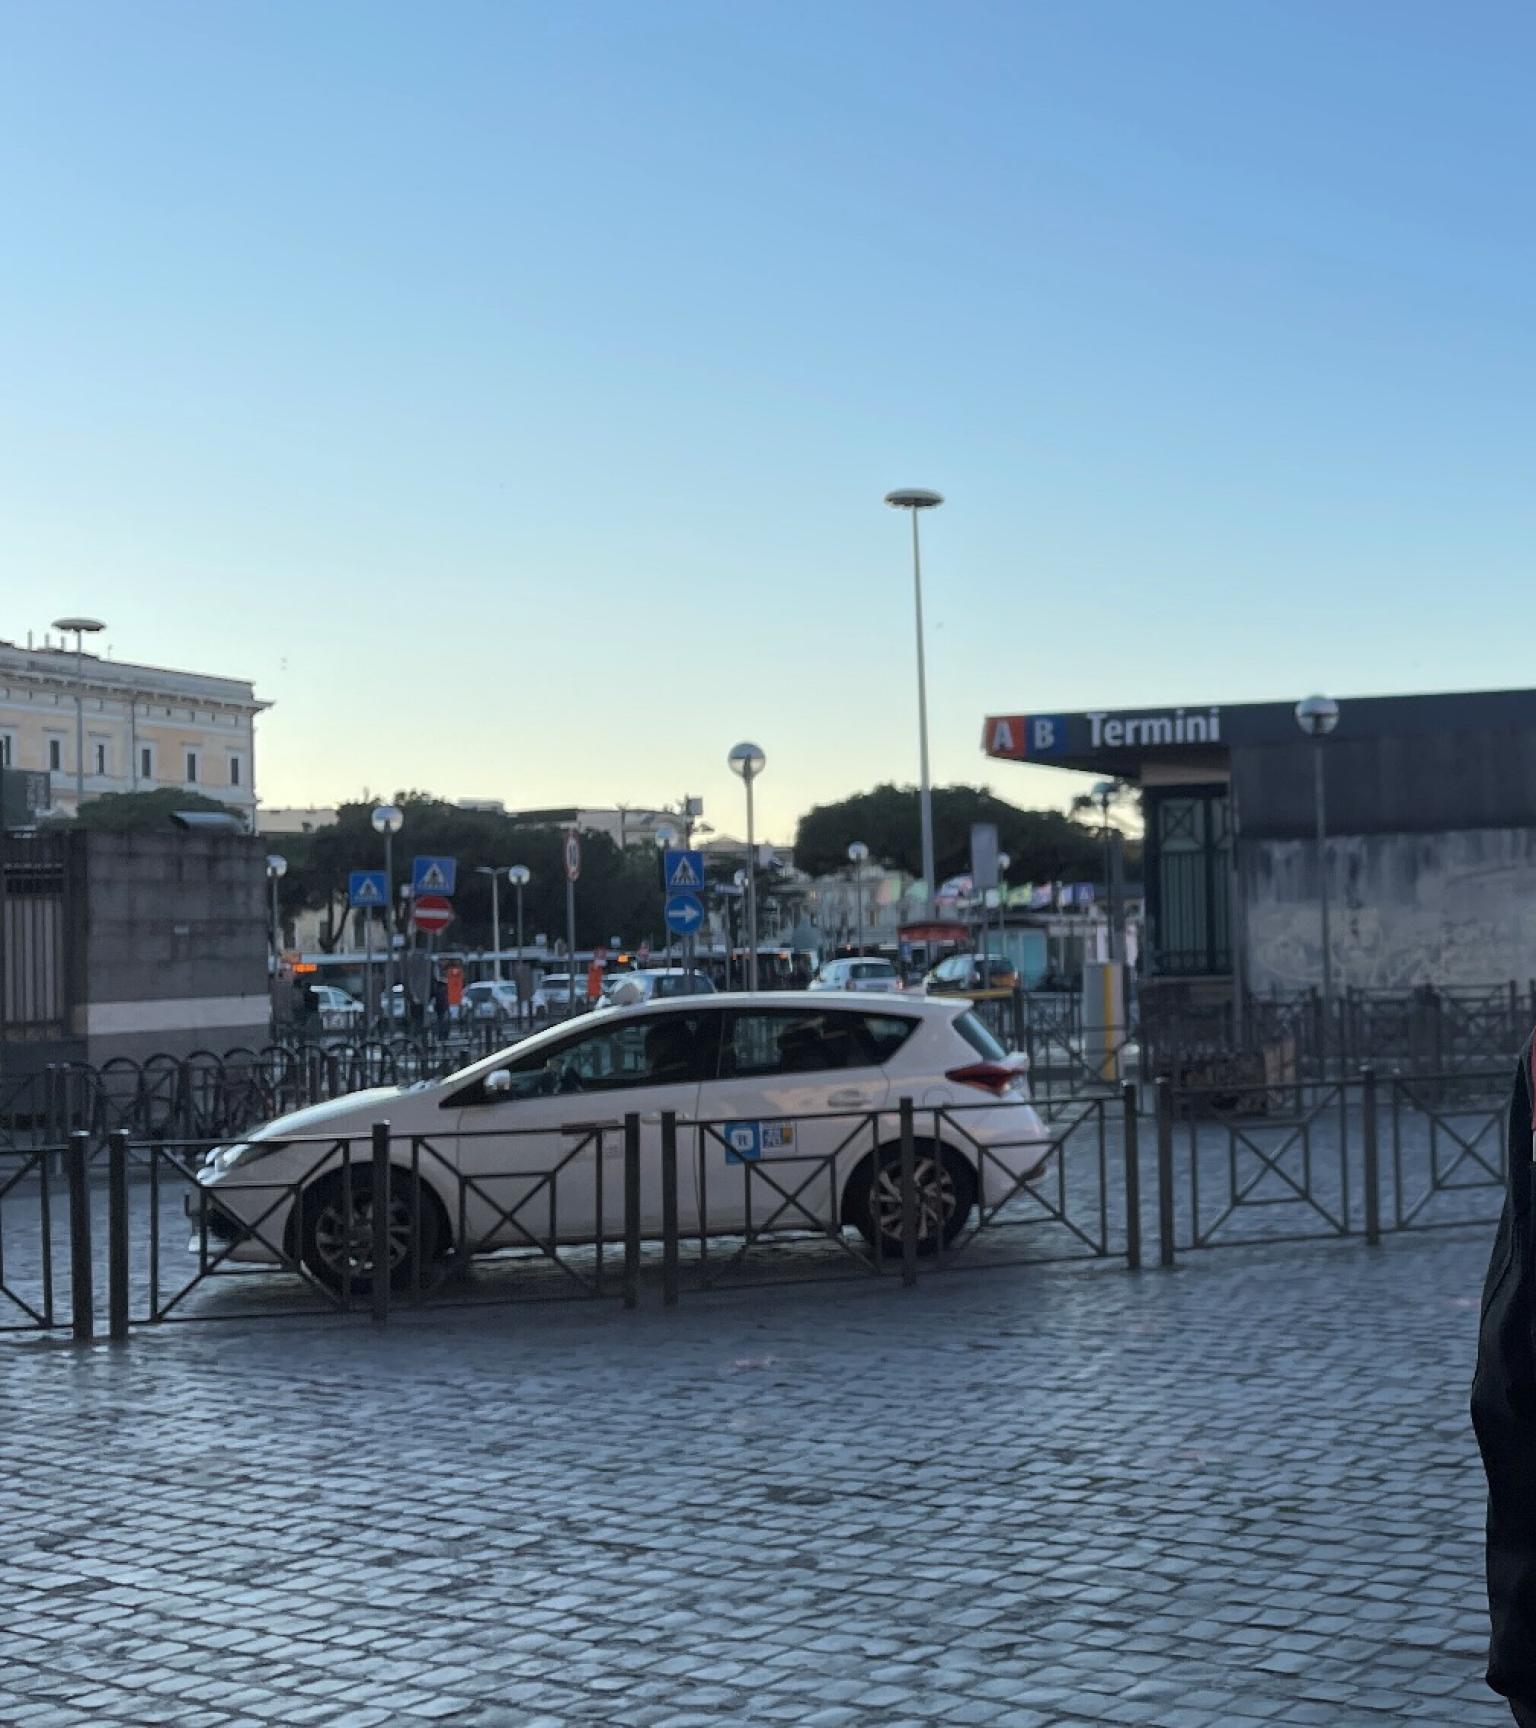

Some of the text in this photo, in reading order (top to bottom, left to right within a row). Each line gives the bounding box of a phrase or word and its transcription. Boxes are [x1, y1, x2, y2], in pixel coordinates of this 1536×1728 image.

[992, 708, 1220, 750] A B Termini
